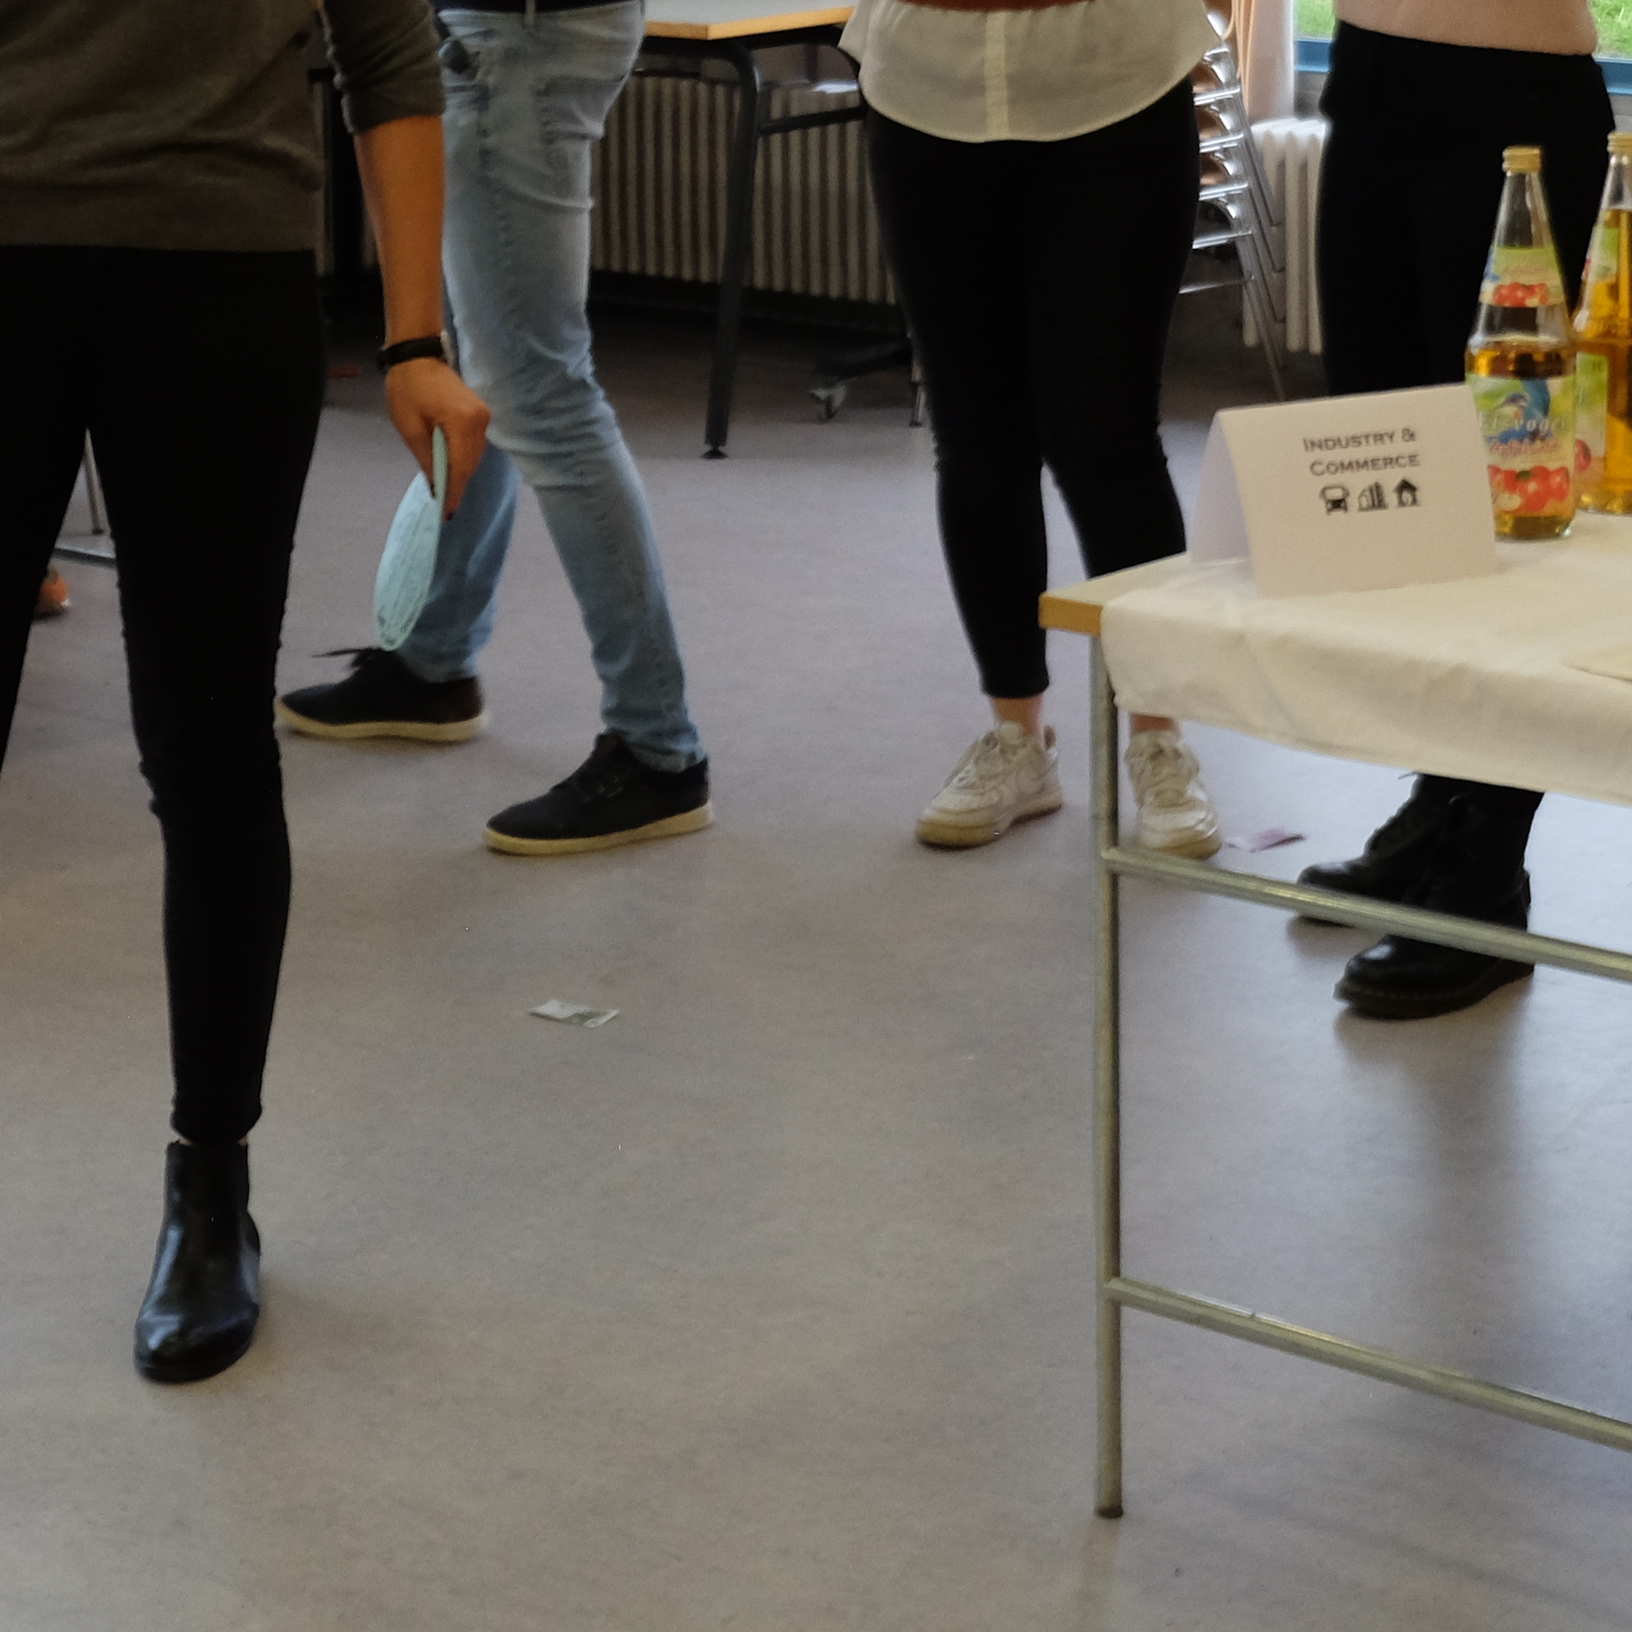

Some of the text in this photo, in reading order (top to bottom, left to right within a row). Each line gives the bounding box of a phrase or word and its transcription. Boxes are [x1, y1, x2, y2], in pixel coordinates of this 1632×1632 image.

[1303, 428, 1416, 452] INDUSTRY &
[1309, 454, 1421, 476] COMMERCE
